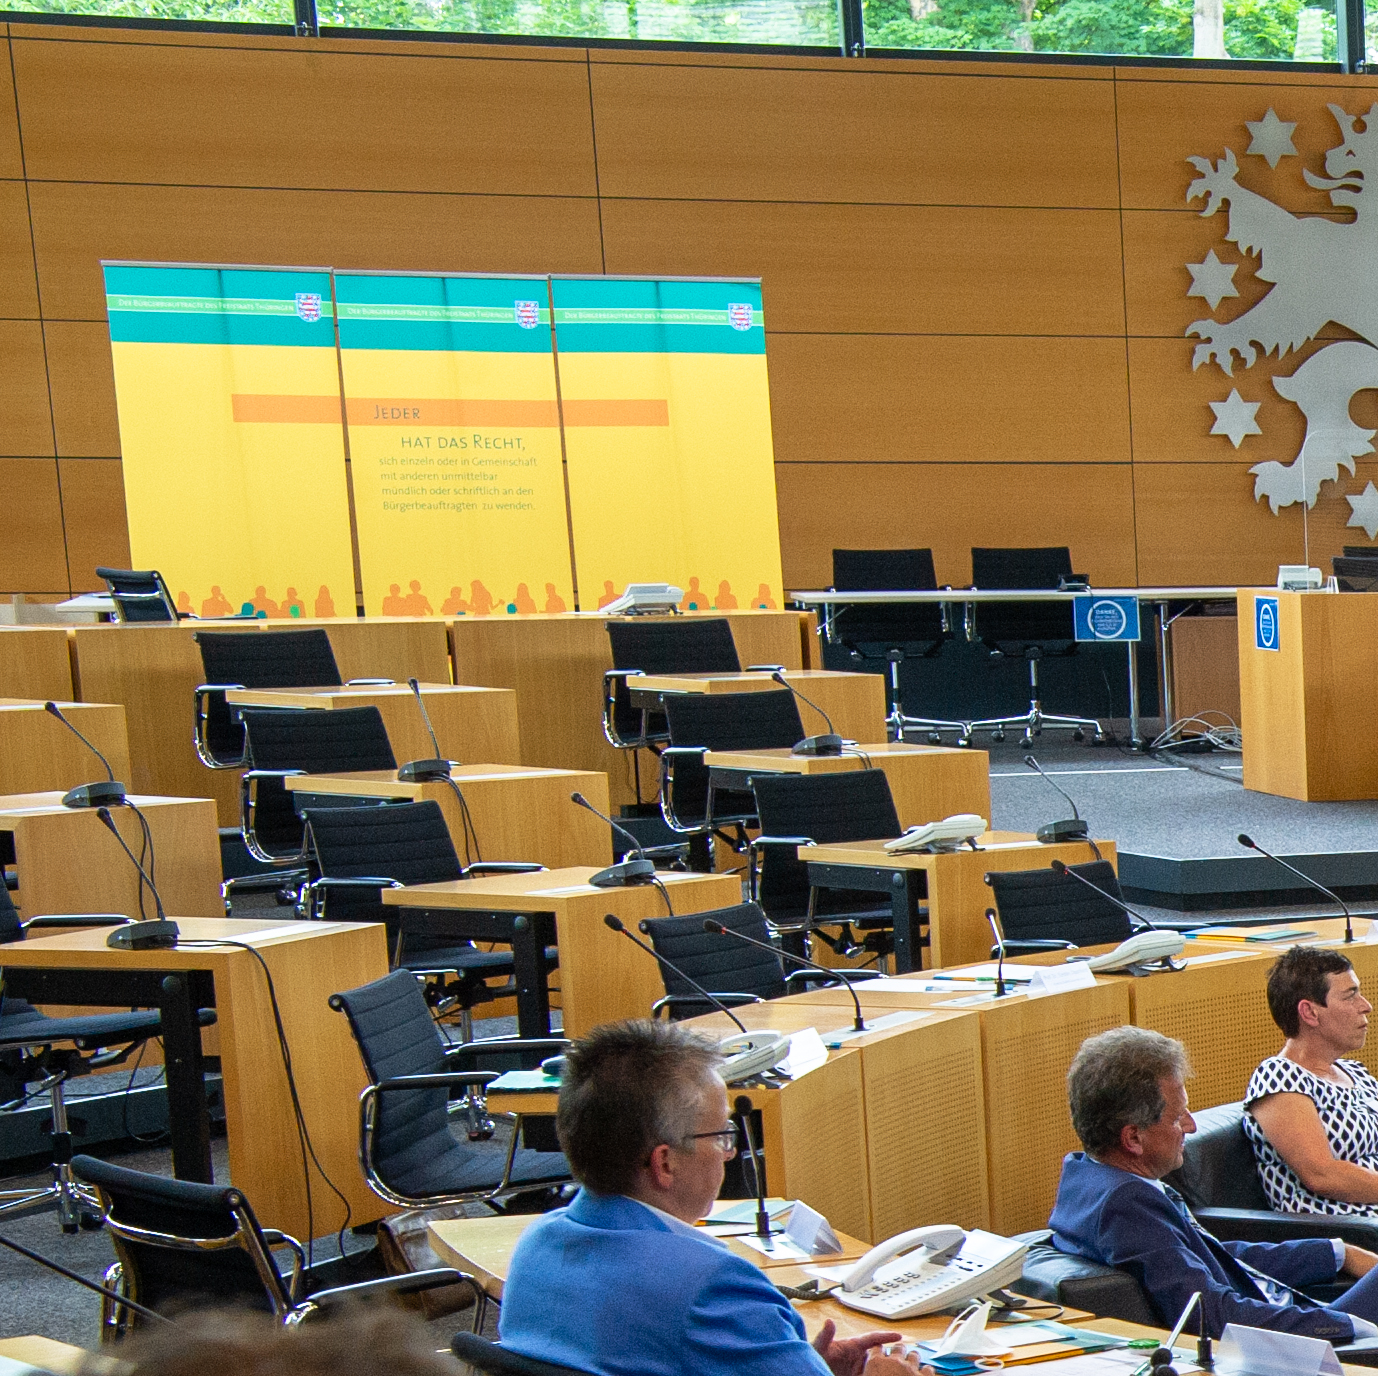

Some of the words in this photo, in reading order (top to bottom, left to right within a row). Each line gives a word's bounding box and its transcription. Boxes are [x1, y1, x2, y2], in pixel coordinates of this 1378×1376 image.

[437, 436, 468, 449] DAS
[473, 434, 526, 451] RECHT,
[379, 456, 398, 467] sich
[400, 456, 435, 467] einzeln
[437, 457, 458, 467] oder
[460, 457, 470, 467] in
[471, 456, 538, 468] Gemeinschaft
[380, 472, 397, 482] mit
[399, 473, 440, 482] anderen
[441, 472, 498, 482] unmittelbar
[381, 486, 428, 497] mündlich
[429, 487, 451, 497] oder
[453, 487, 500, 497] schriftlich
[502, 488, 514, 497] an
[516, 487, 534, 497] den
[383, 501, 478, 513] Bürgerbeauftragten
[482, 503, 494, 512] zu
[495, 502, 536, 512] wenden.
